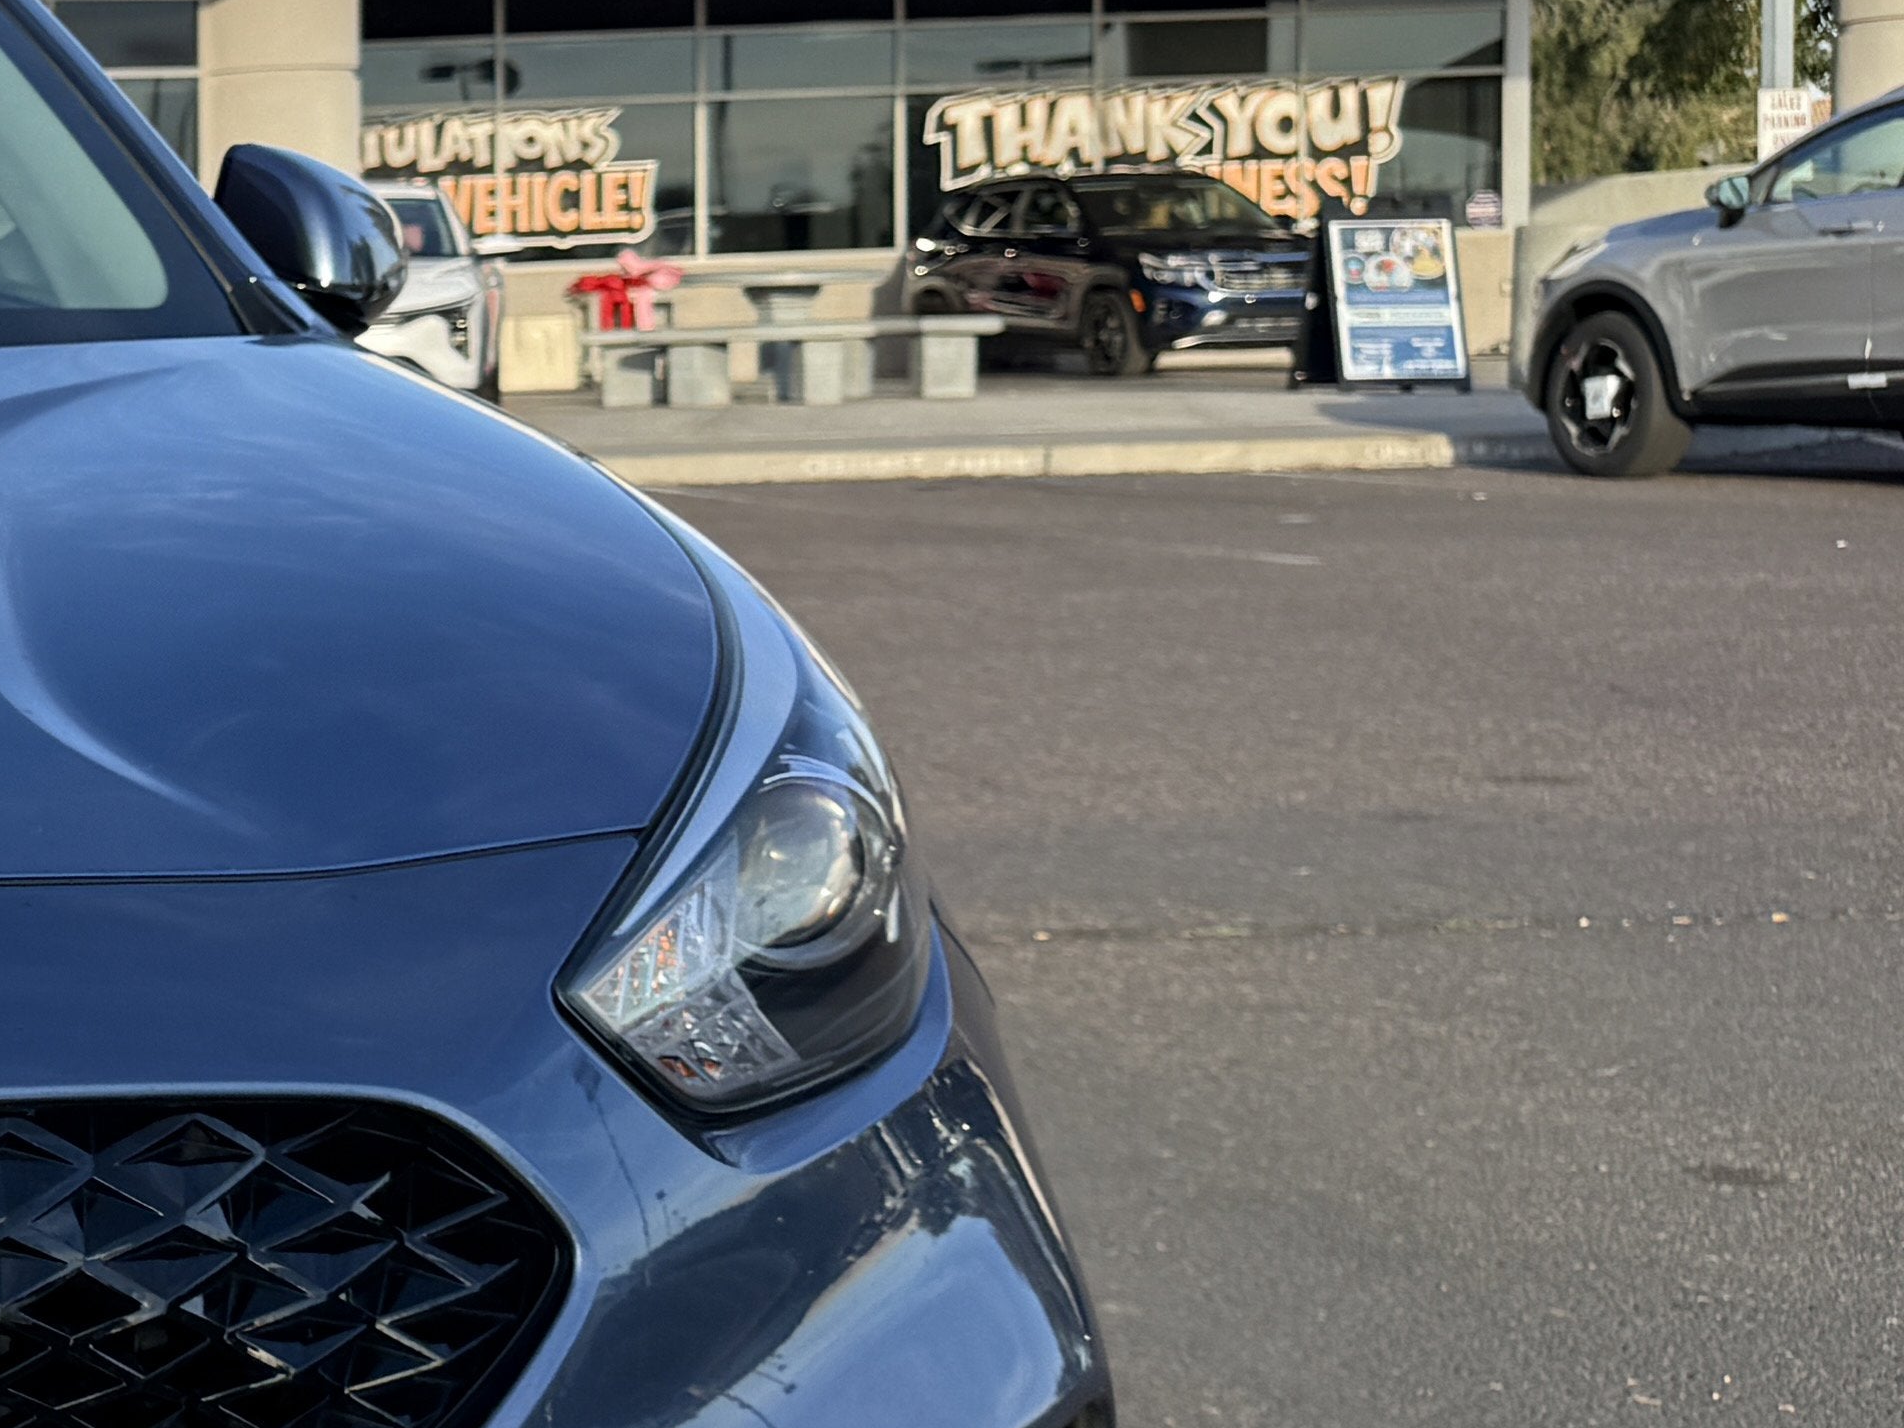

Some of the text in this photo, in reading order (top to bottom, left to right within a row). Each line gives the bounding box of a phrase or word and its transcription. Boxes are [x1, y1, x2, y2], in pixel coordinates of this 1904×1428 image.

[943, 78, 1396, 168] THANK YOU!
[437, 170, 646, 234] VEHICLE!
